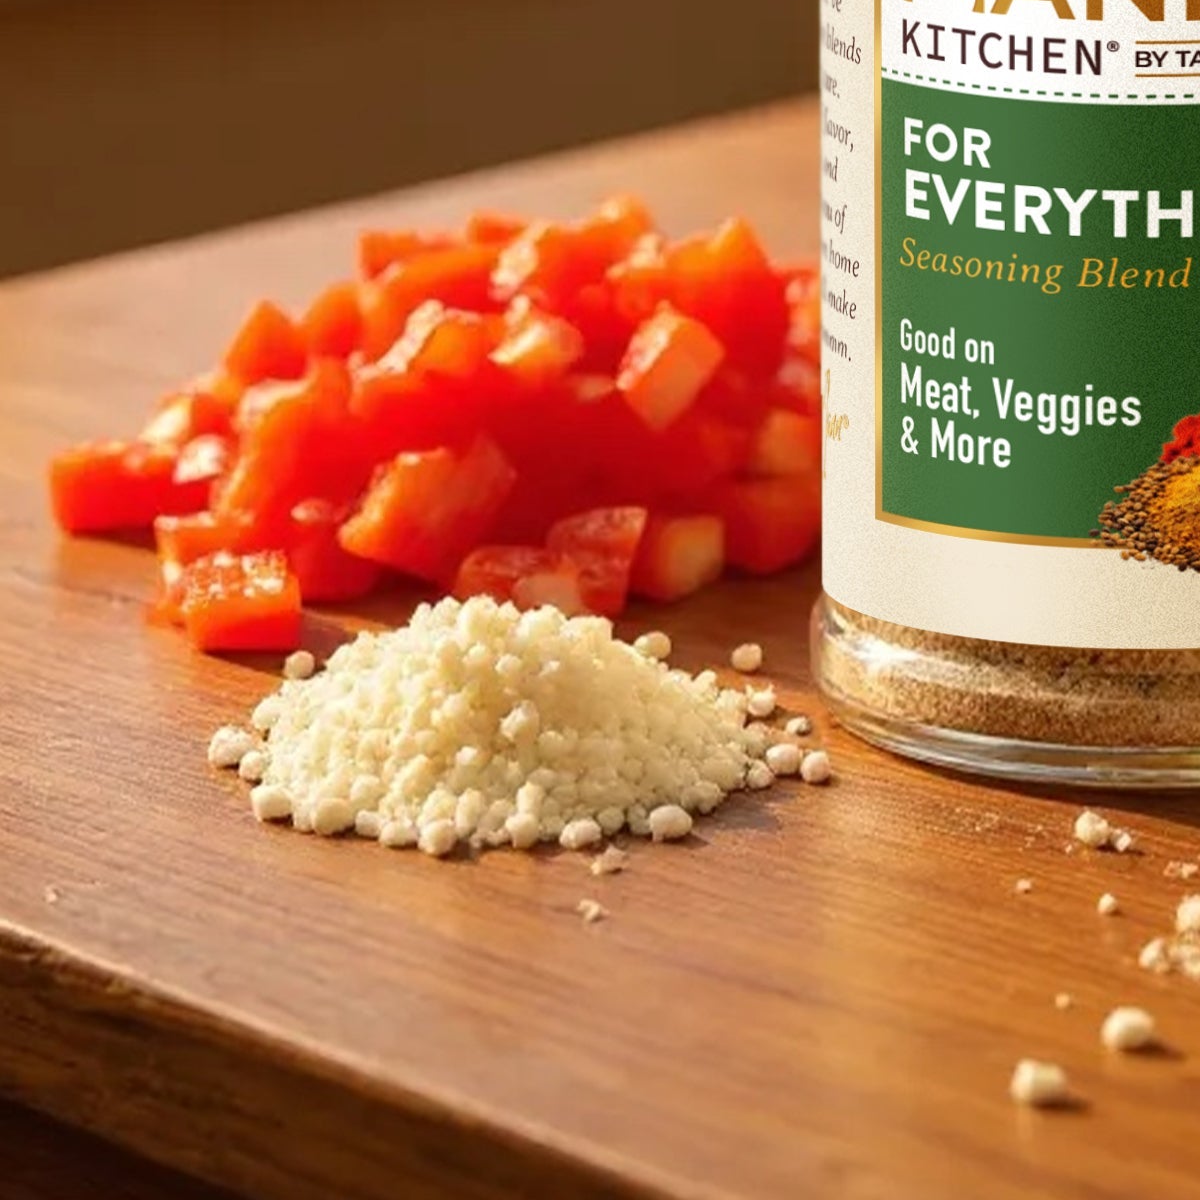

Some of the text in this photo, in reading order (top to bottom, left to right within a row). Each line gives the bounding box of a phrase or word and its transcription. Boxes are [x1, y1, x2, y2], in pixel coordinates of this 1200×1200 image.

[826, 23, 862, 66] blends
[1135, 50, 1168, 68] BY
[903, 116, 992, 169] FOR
[834, 204, 848, 236] of
[829, 239, 860, 278] home
[900, 237, 1193, 295] Seasoning Blend
[828, 288, 857, 320] make
[900, 318, 995, 366] Good on
[901, 361, 980, 420] Meat,
[992, 377, 1142, 437] Veggies
[900, 416, 1012, 469] & More
